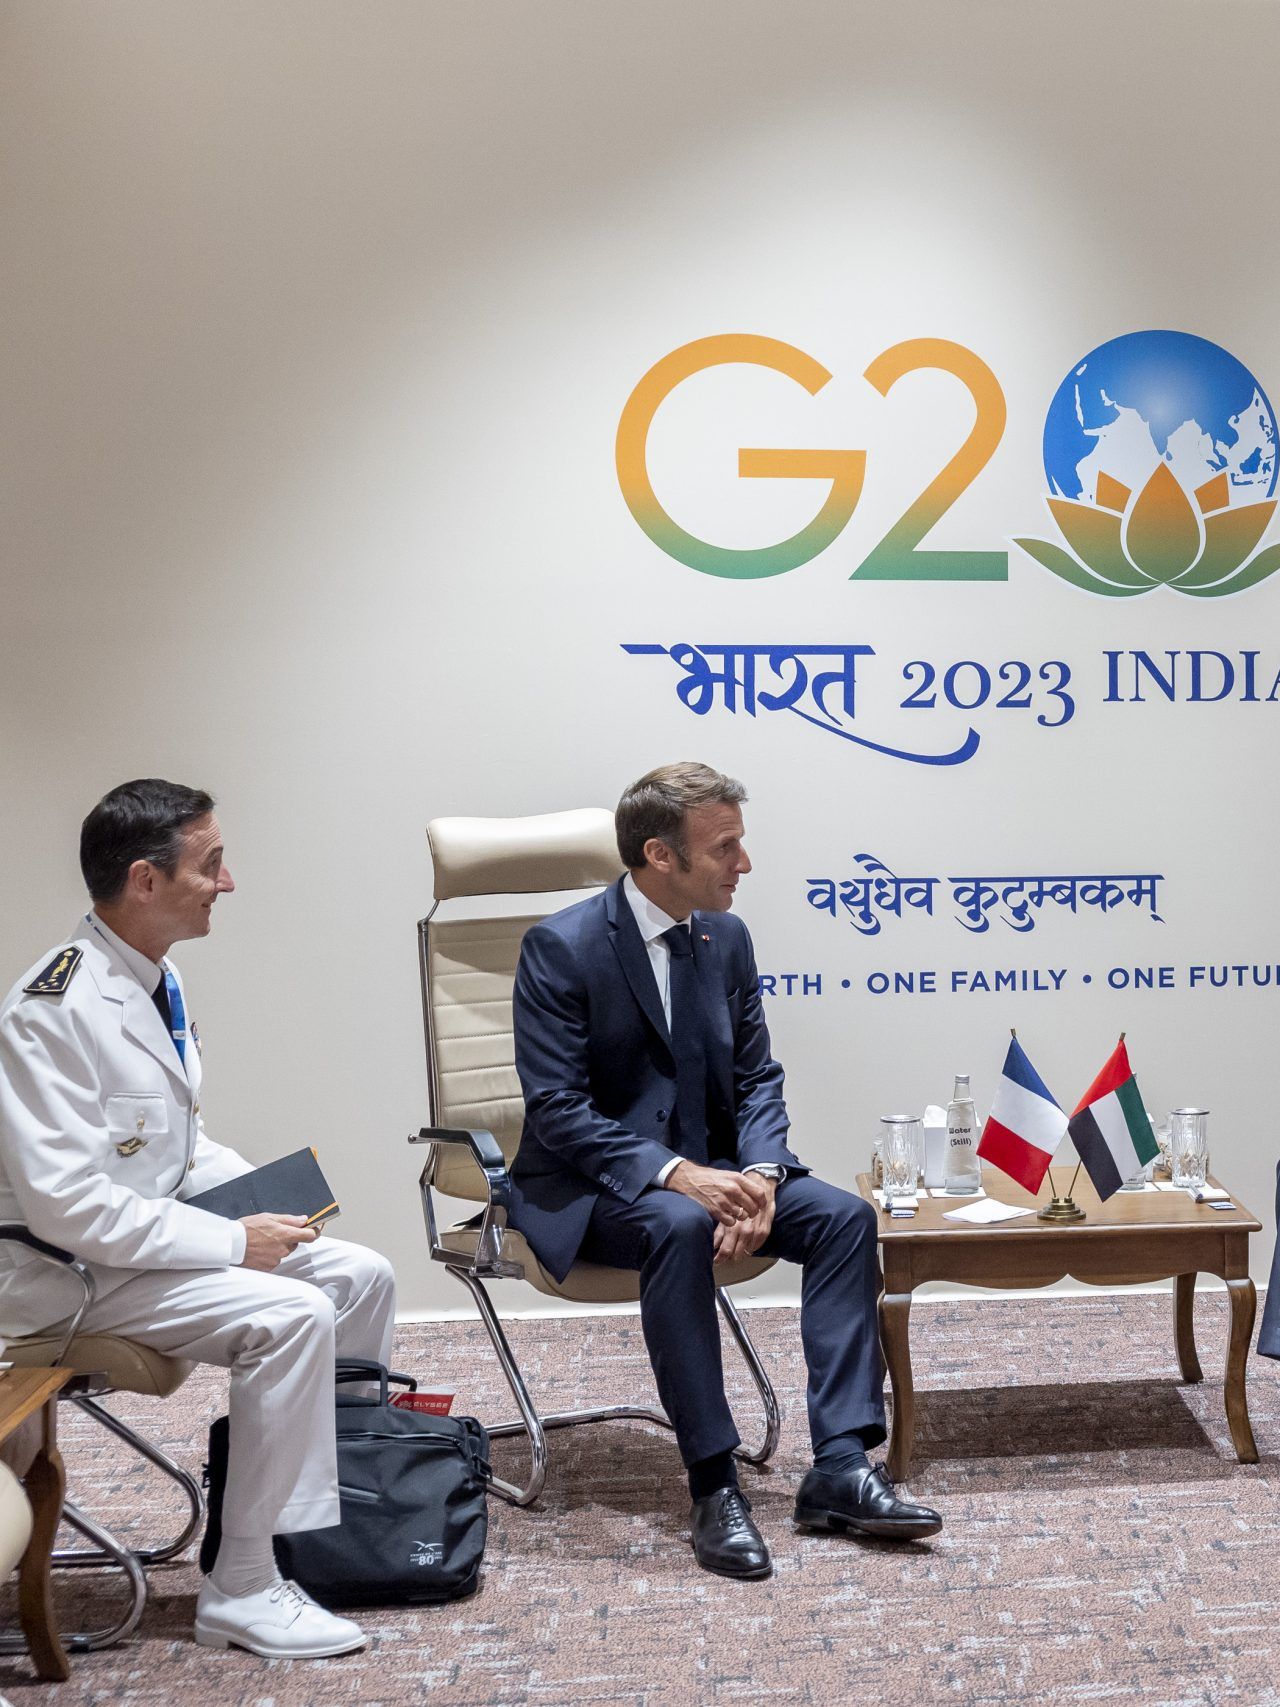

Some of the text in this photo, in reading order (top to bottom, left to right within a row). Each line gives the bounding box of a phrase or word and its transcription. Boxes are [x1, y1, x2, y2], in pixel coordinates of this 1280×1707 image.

[620, 643, 981, 767] भारत
[899, 660, 1076, 727] 2023
[759, 973, 822, 996] RTH
[867, 971, 936, 994] ONE
[951, 968, 1067, 993] FAMILY
[1107, 966, 1176, 990] ONE
[948, 1127, 972, 1135] Water
[950, 1137, 972, 1147] (Still)
